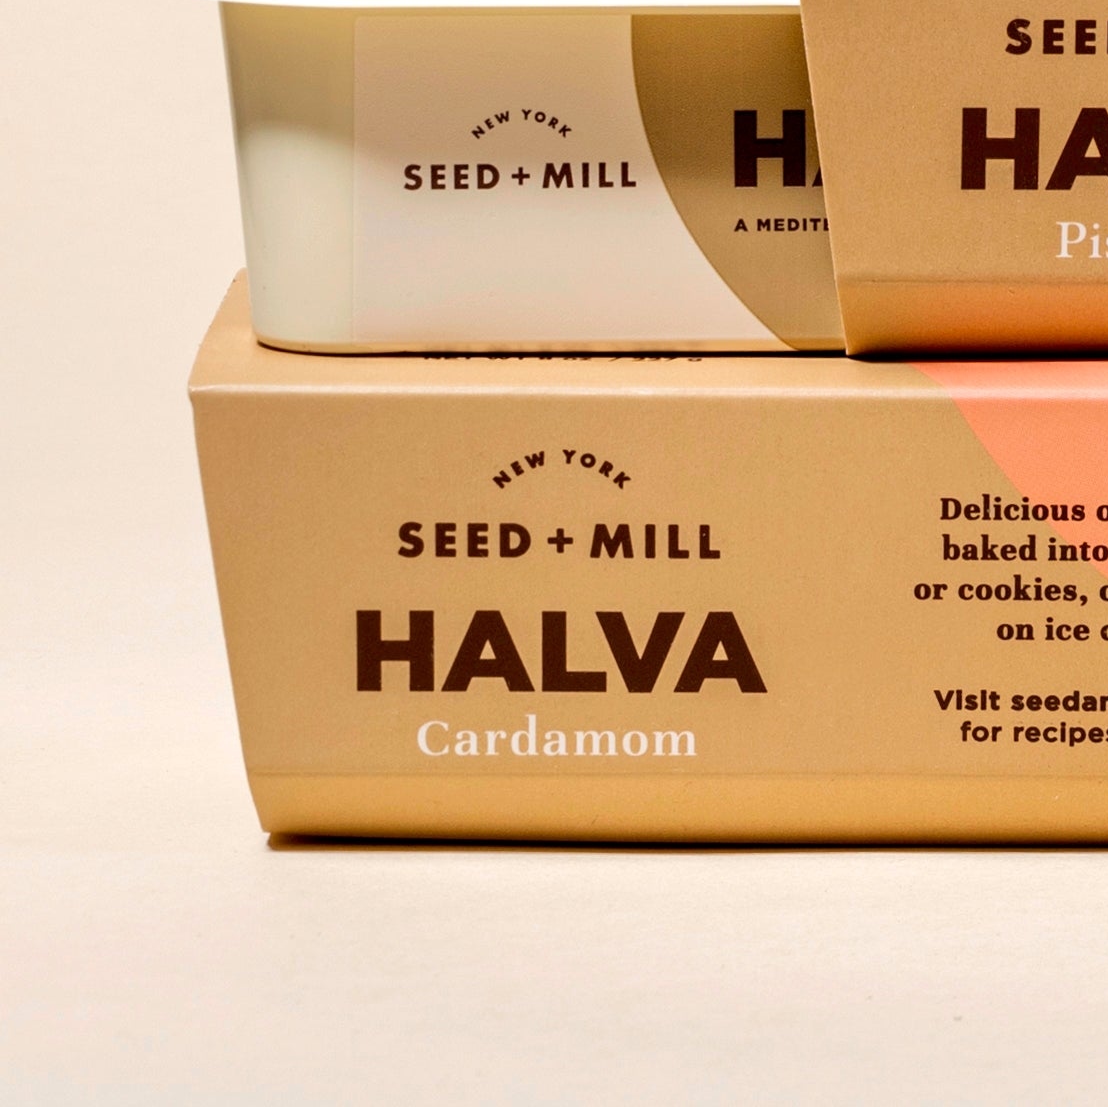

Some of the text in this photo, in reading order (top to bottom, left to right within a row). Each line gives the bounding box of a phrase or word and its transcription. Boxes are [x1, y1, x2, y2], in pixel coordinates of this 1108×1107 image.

[471, 109, 572, 139] NEW YORK
[734, 110, 824, 188] H
[404, 161, 637, 191] SEED + MILL
[734, 218, 748, 232] A
[492, 449, 631, 490] NEW YORK
[940, 493, 1086, 522] Delicious
[397, 521, 721, 560] SEED + MILL
[941, 533, 1038, 562] baked
[913, 583, 948, 601] or
[957, 574, 1088, 607] cookies,
[996, 623, 1035, 641] on
[1045, 616, 1090, 642] ice
[356, 609, 768, 694] HALVA
[933, 689, 1001, 711] Visit
[417, 714, 697, 757] Cardamom
[960, 720, 1003, 743] for
